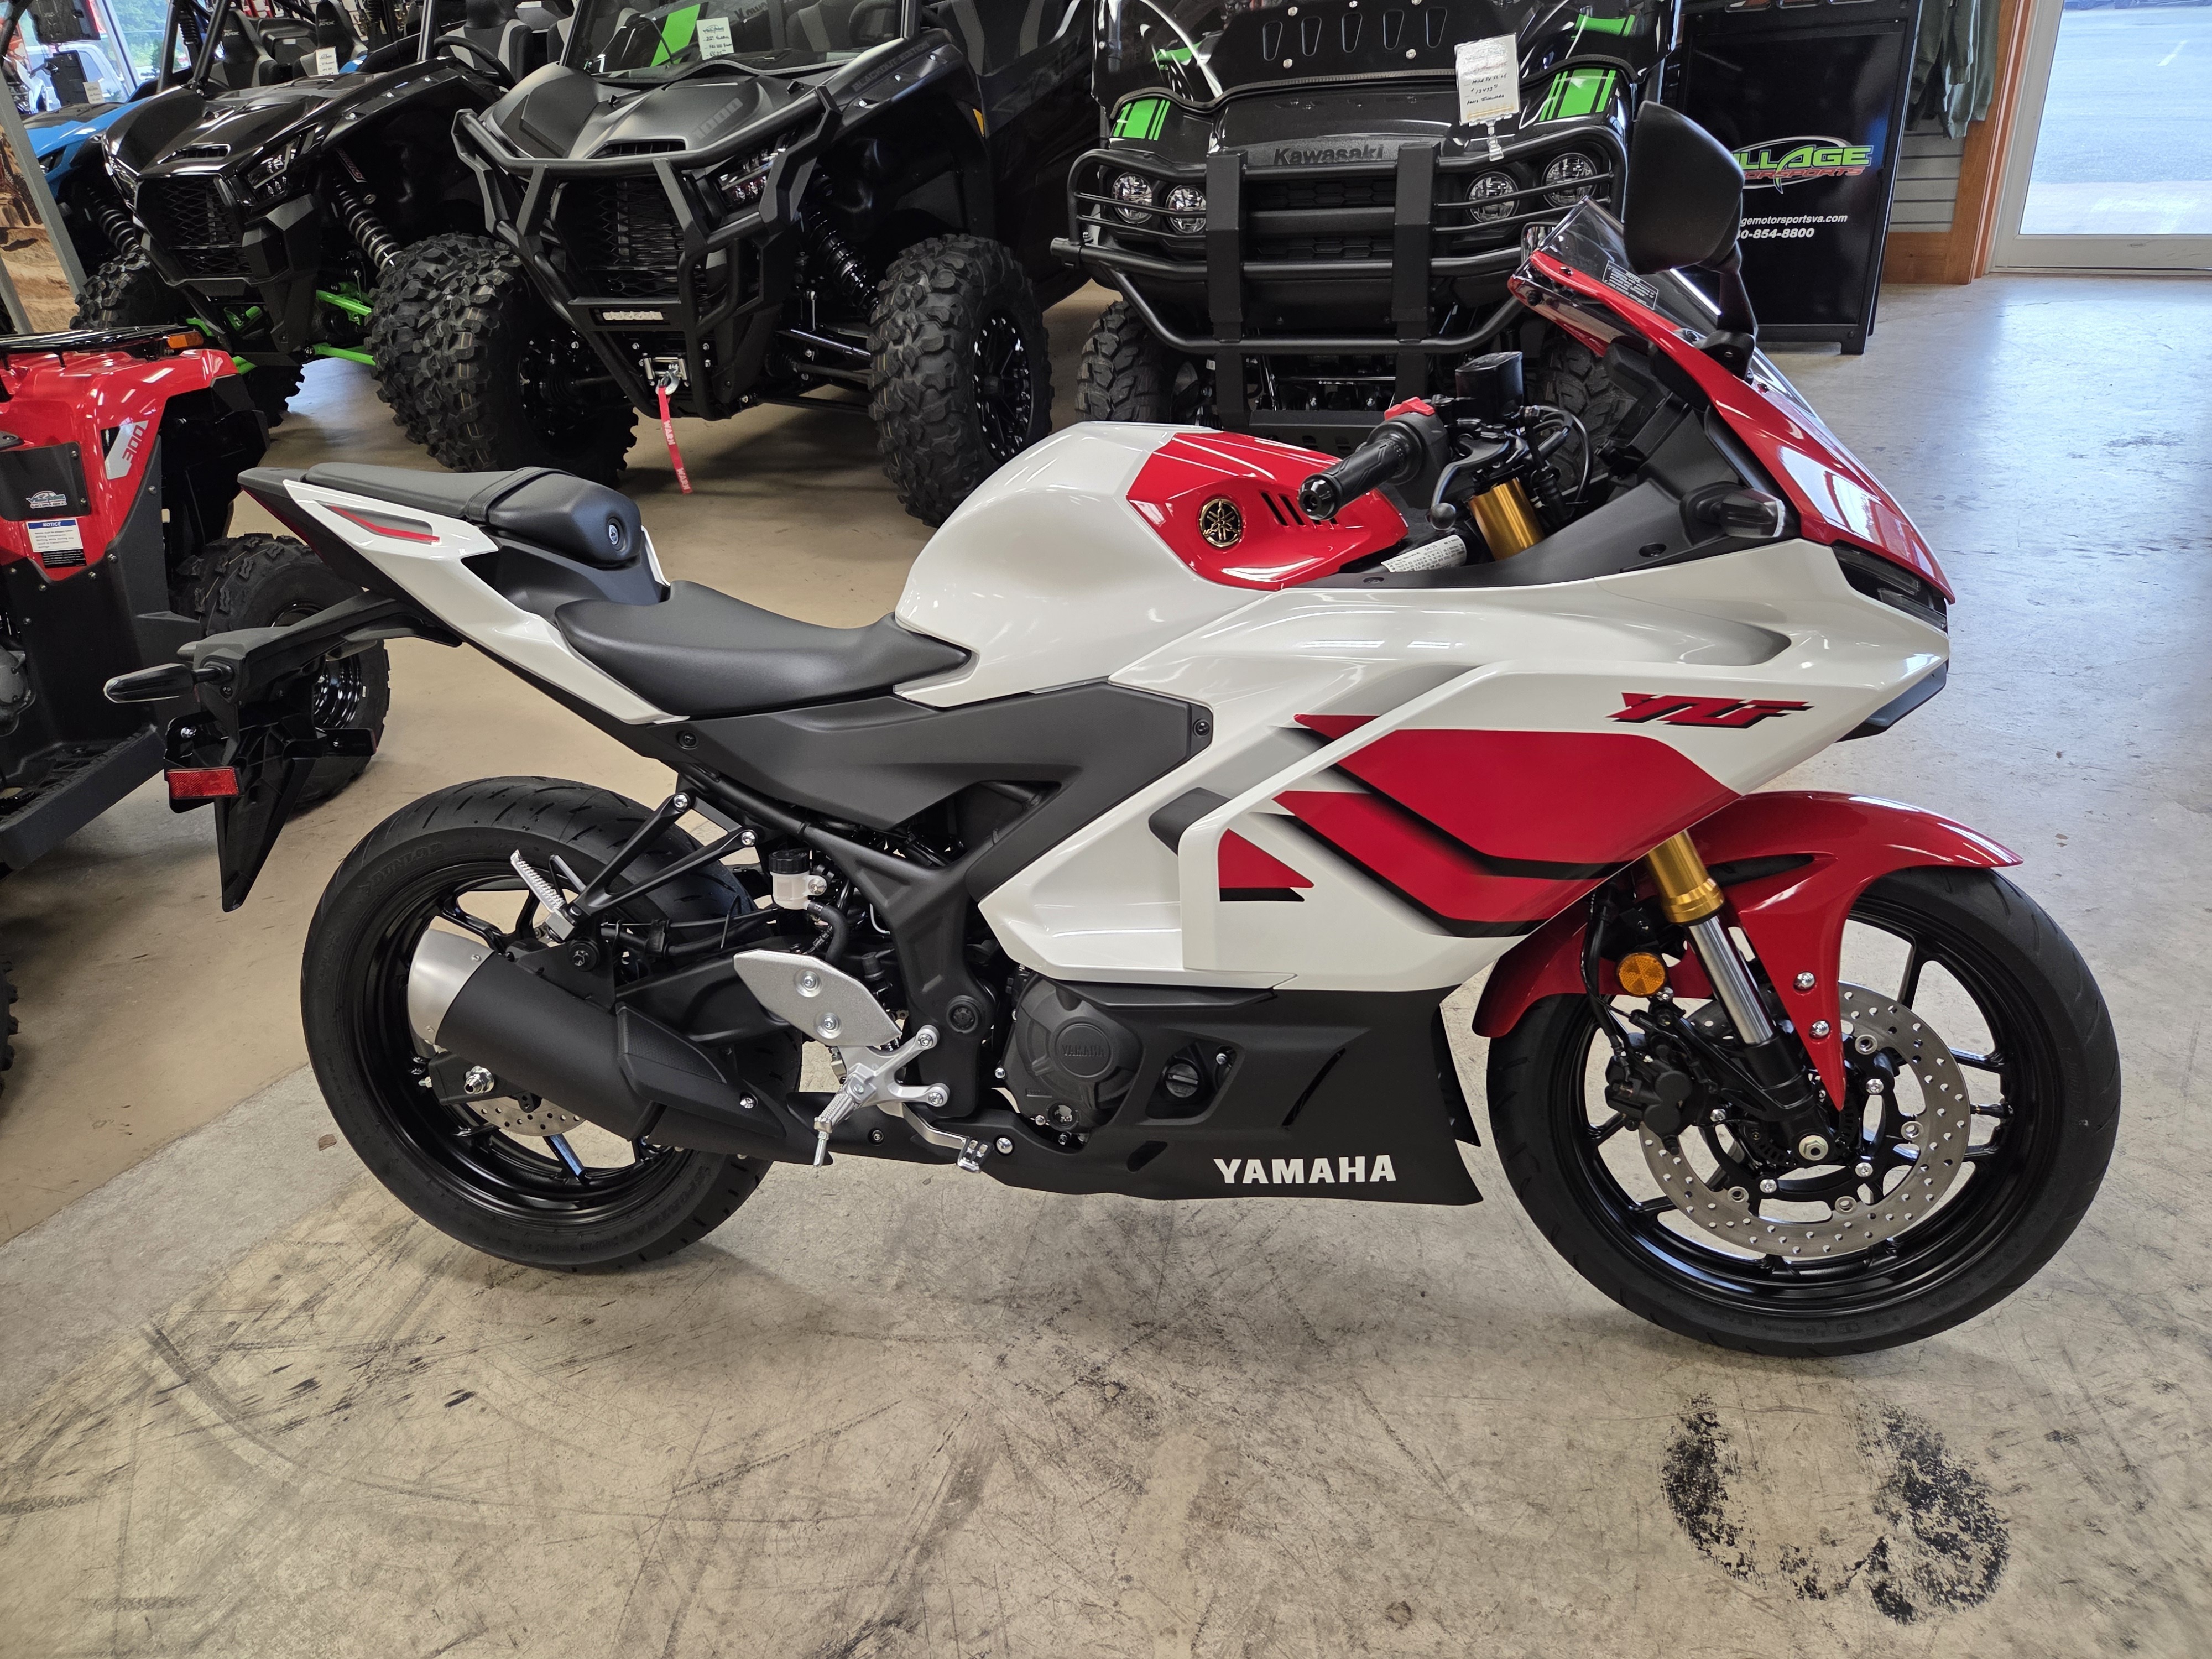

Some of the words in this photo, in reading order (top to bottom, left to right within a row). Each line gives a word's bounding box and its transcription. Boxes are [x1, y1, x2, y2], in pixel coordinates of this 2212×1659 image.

[852, 57, 898, 92] BLACKOUT
[691, 98, 743, 141] 1000
[1273, 144, 1384, 166] Kawasaki
[1744, 166, 1866, 180] ORSPORTS
[664, 420, 676, 445] WARN
[677, 467, 691, 490] WARN
[1605, 692, 1815, 729] YZF
[370, 841, 444, 888] DUNLOP
[1062, 1044, 1107, 1057] YAMAHA
[1213, 1154, 1397, 1184] YAMAHA
